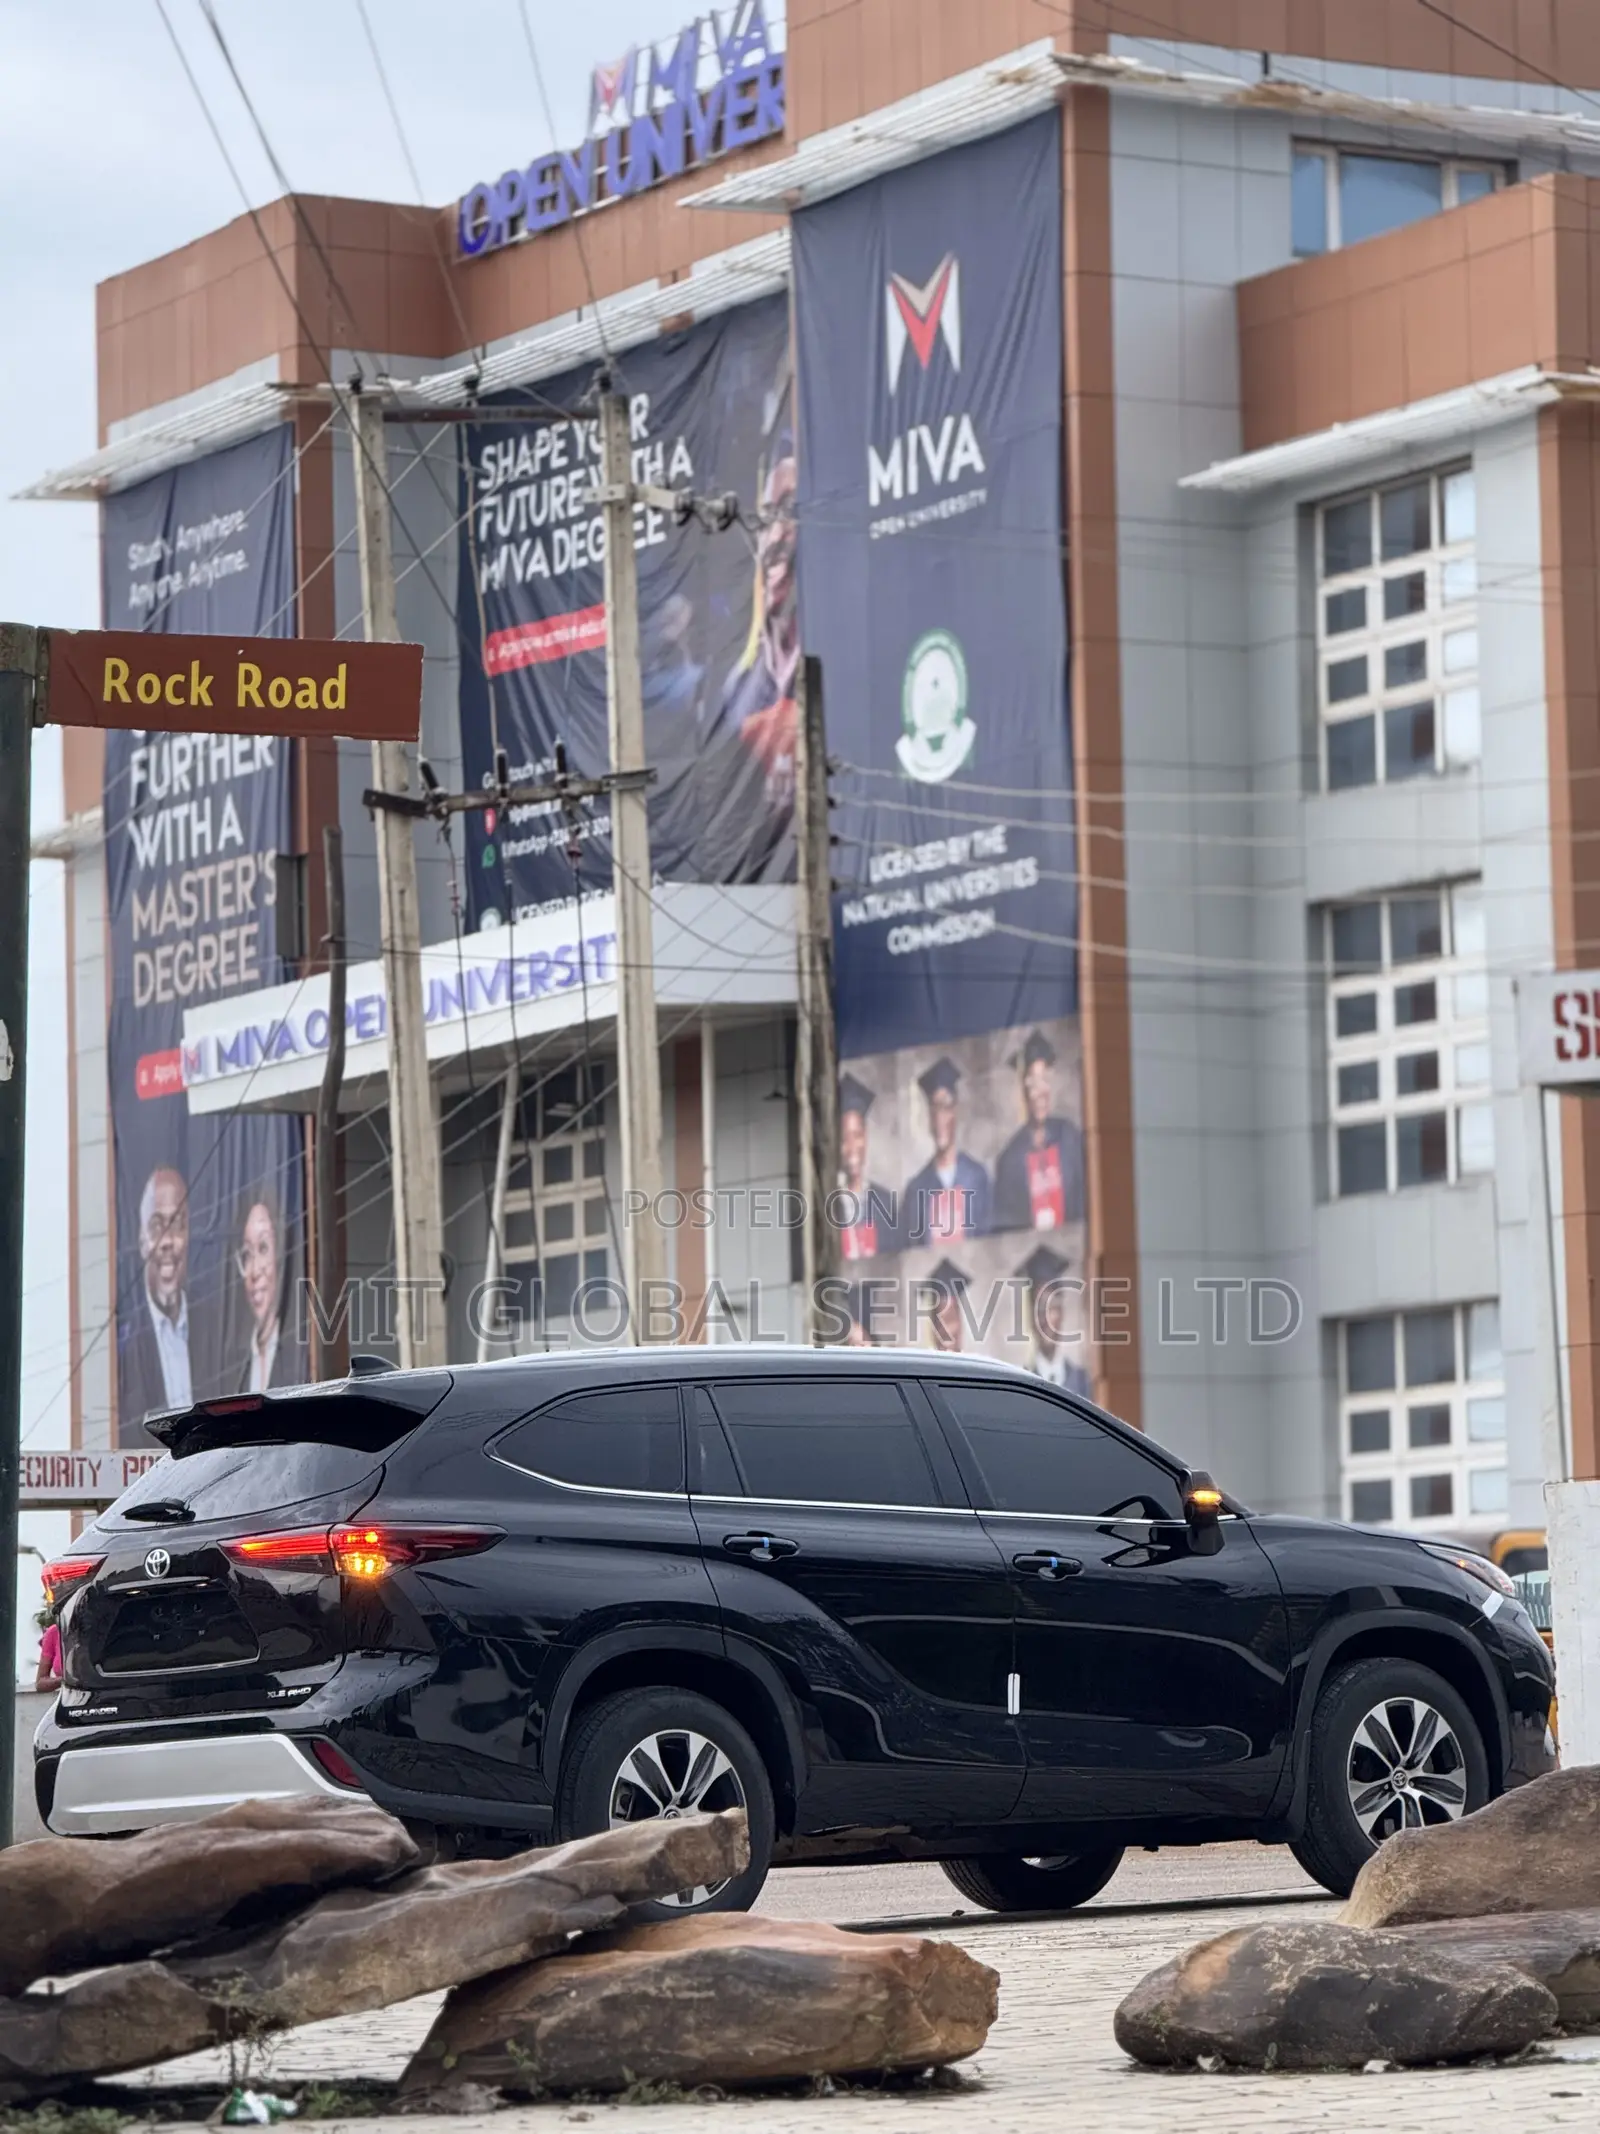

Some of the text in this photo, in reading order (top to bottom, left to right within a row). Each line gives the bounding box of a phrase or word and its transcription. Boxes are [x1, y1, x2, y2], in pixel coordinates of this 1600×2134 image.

[459, 136, 598, 255] OPEN
[477, 418, 569, 491] SHAPE
[479, 469, 586, 543] FUTURE
[669, 435, 694, 480] A
[868, 413, 986, 507] MIVA
[552, 503, 667, 576] DEGEE
[103, 657, 348, 710] Rock Road
[130, 736, 275, 807] FURTHER
[128, 793, 245, 872] WITH A
[132, 848, 277, 943] MASTER'S
[133, 922, 260, 1008] DEGREE
[216, 1018, 302, 1074] MIVA
